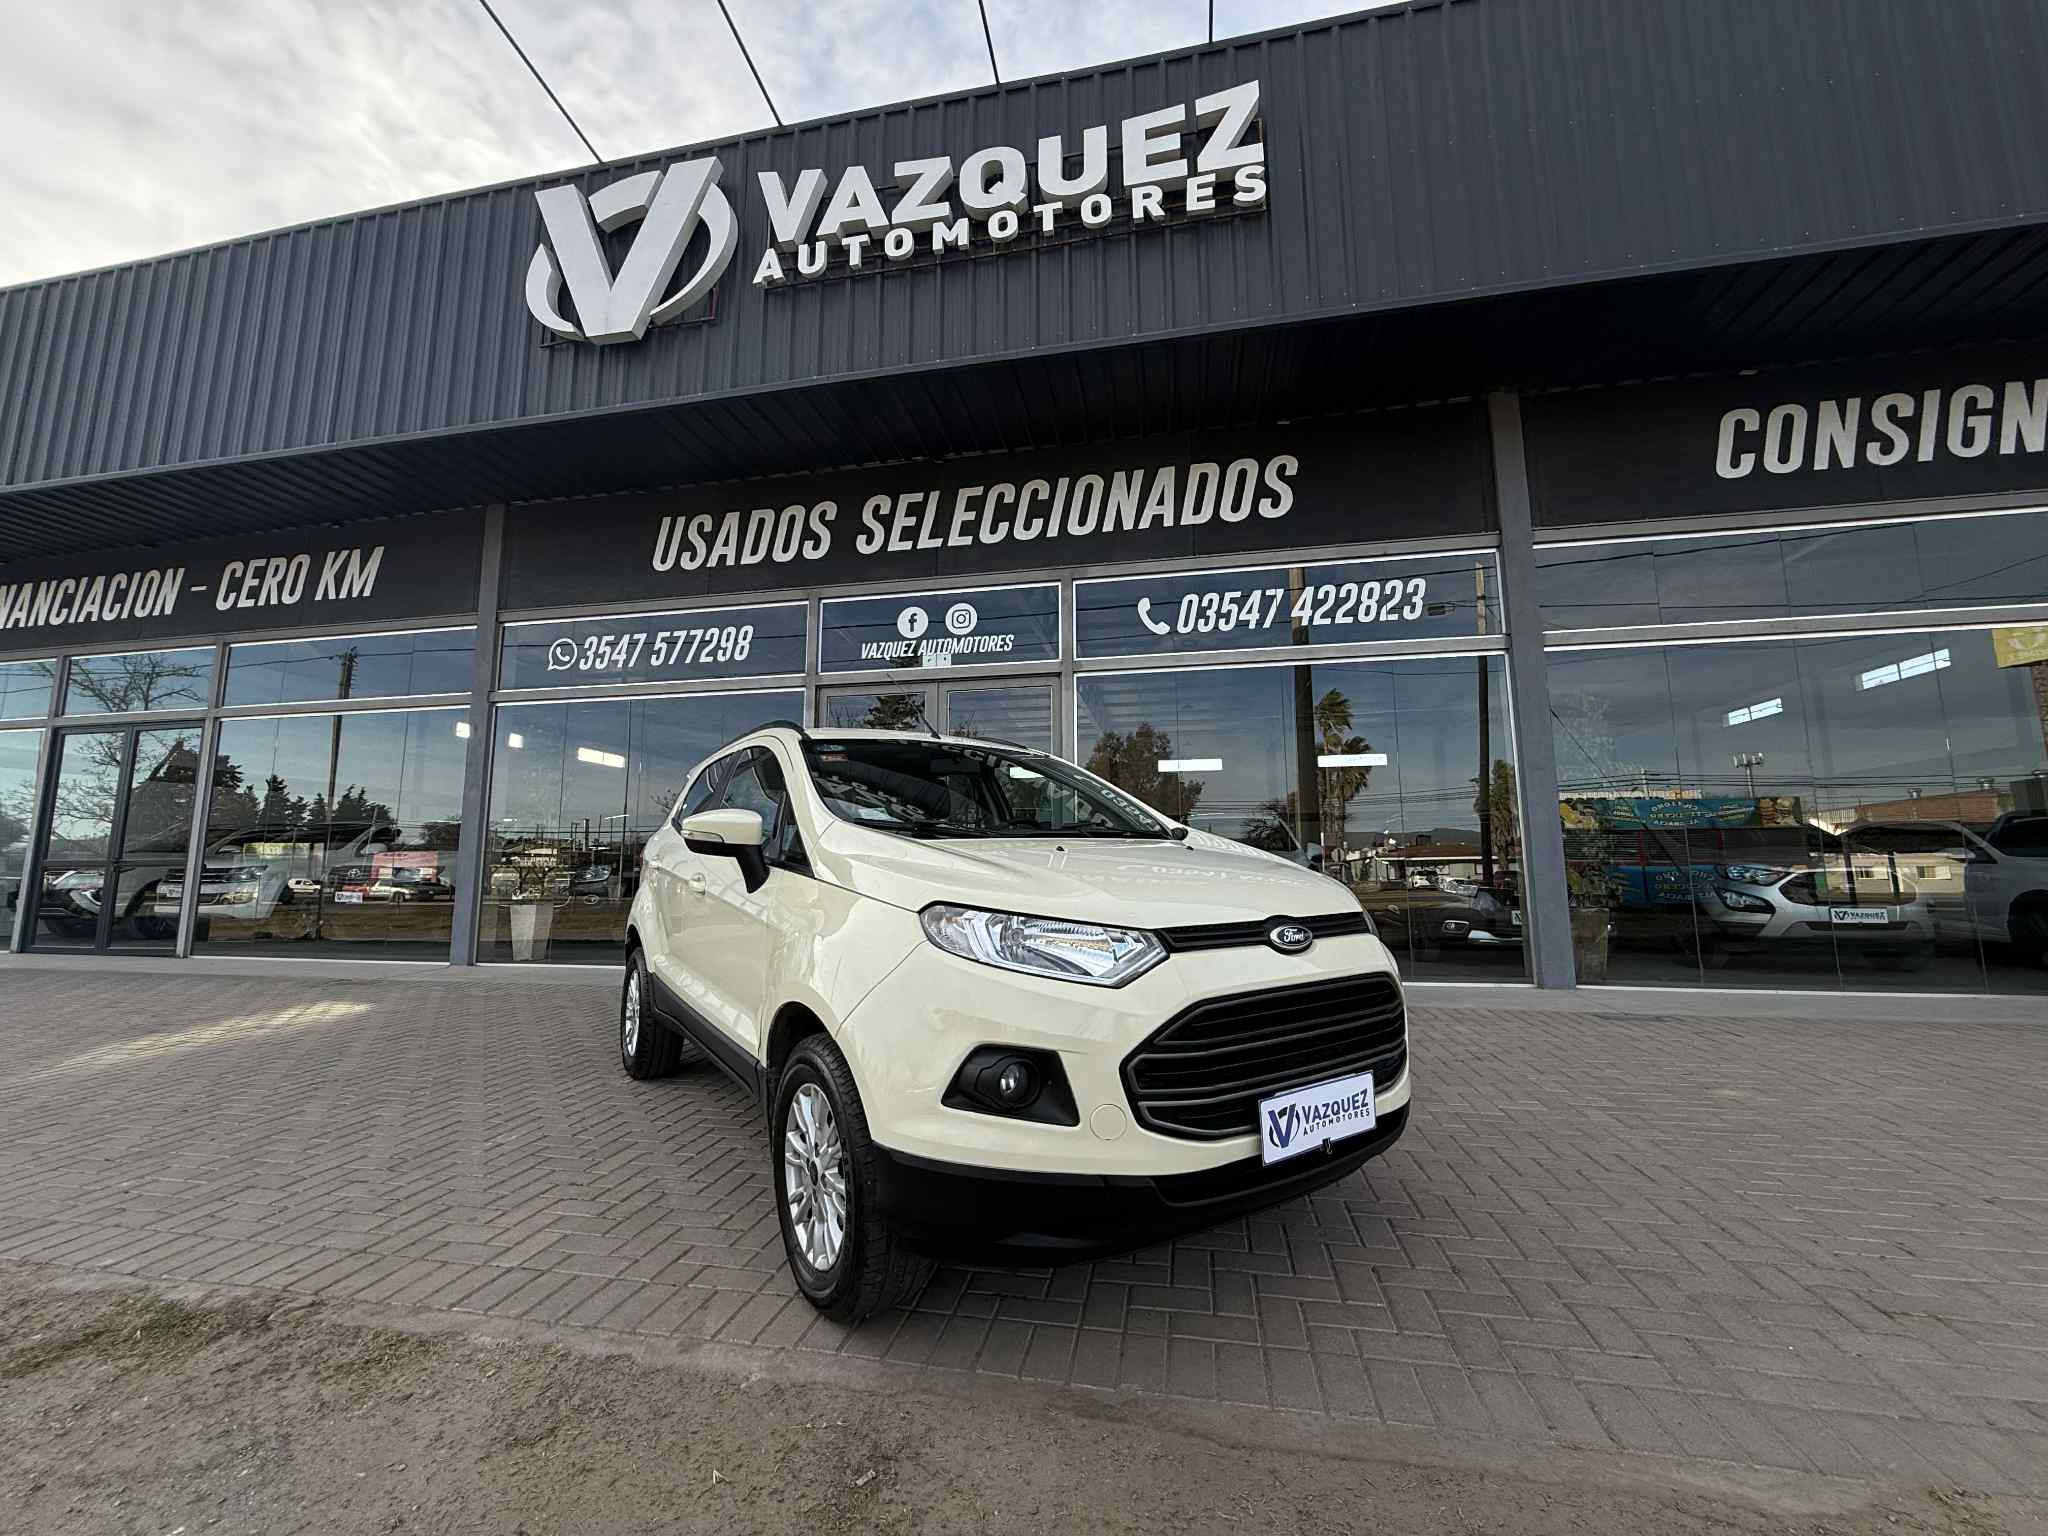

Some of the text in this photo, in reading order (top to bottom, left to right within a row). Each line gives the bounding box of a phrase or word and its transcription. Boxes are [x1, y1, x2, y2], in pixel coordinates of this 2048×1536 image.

[758, 80, 1263, 252] VAZQUEZ
[752, 165, 1267, 288] AUTOMOTORES
[1715, 378, 2048, 479] CONSIGN
[651, 455, 1299, 571] USADOS SELECCIONADOS
[215, 554, 311, 611] CERO
[315, 546, 384, 600] KM
[1176, 578, 1426, 634] 03547 422823
[579, 625, 753, 670] 3547 577298
[861, 634, 1015, 660] VAZQUEZ AUTOMOTORES
[1284, 928, 1305, 942] Ford
[1302, 1088, 1369, 1124] VAZQUEZ
[1303, 1107, 1371, 1137] AUTOMOTORES
